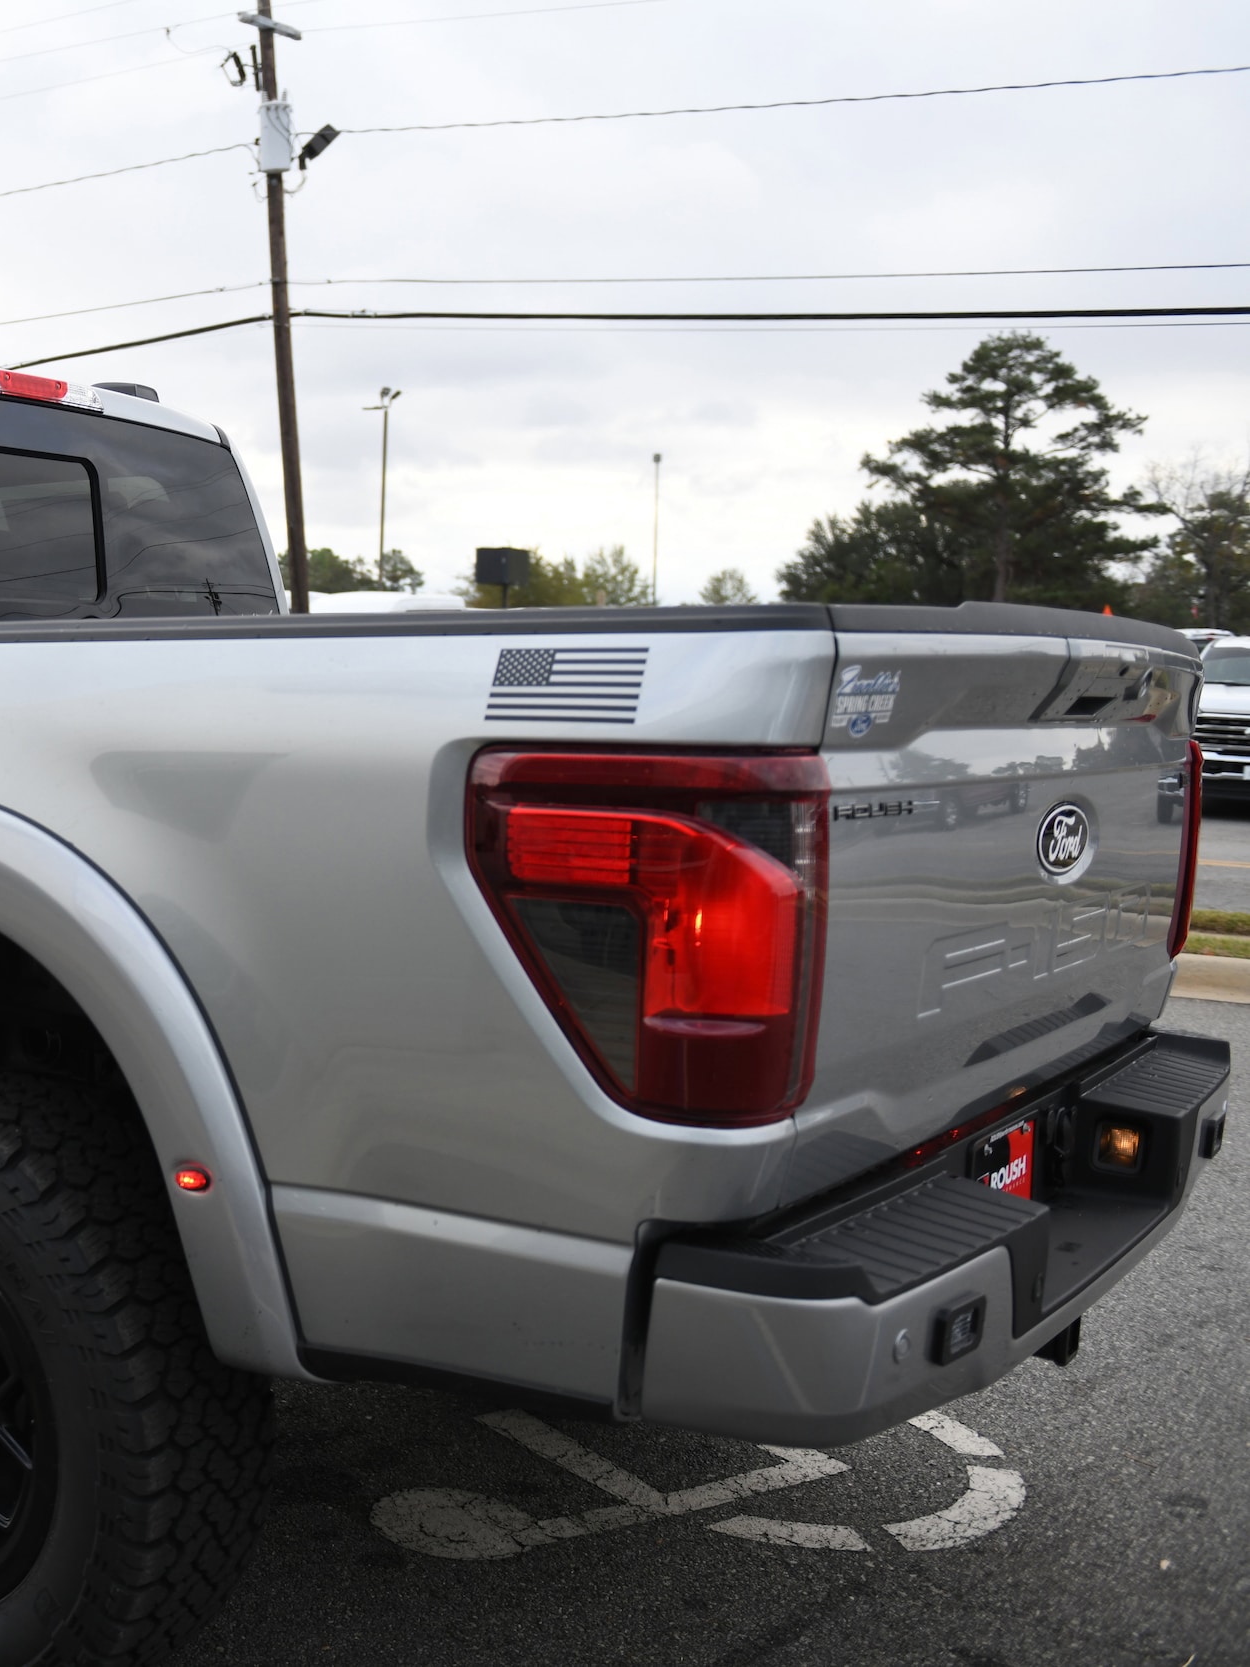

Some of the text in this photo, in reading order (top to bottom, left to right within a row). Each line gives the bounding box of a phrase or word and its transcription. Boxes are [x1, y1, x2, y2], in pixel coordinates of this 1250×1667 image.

[836, 694, 896, 714] SPRING CREEK
[833, 800, 914, 822] ROUSH
[1047, 814, 1084, 862] Ford
[990, 1154, 1027, 1190] ROUSH
